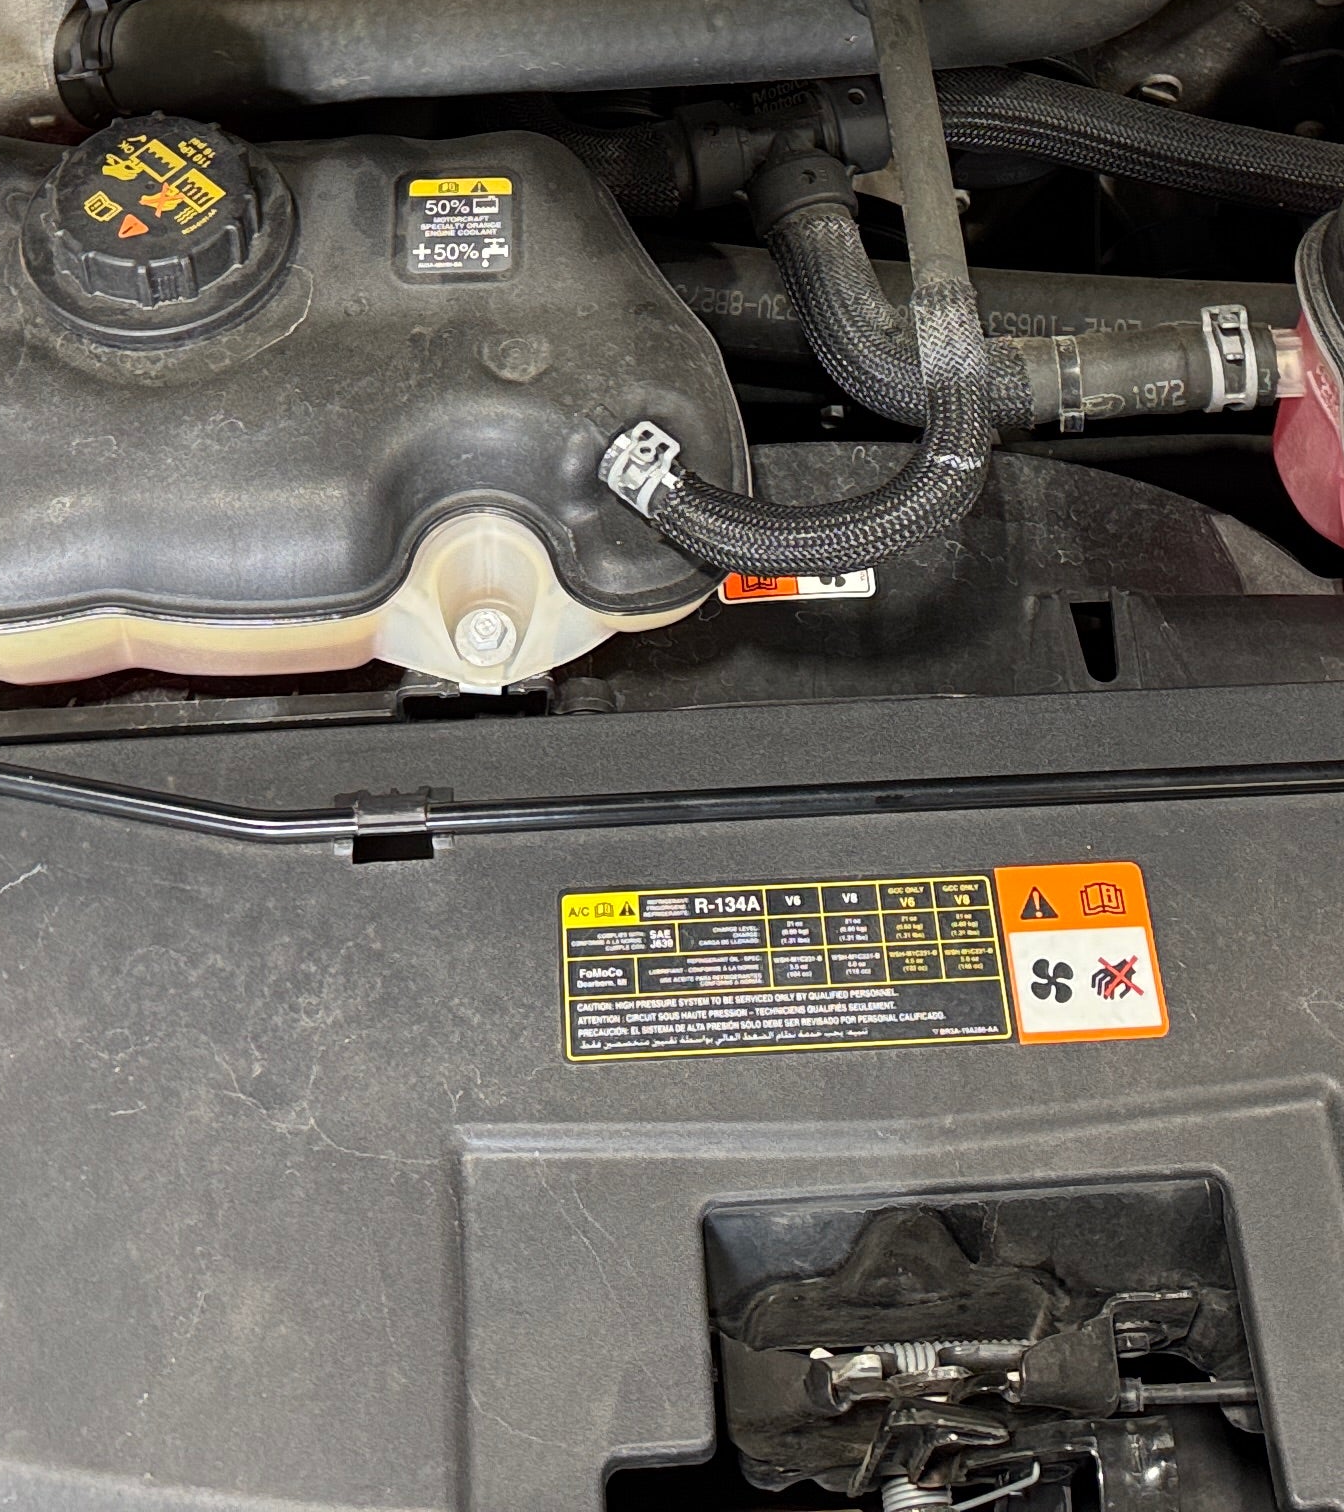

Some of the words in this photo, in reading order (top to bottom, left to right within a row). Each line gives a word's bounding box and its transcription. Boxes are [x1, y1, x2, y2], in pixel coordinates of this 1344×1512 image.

[117, 140, 135, 153] OK
[425, 199, 470, 215] 50%
[433, 215, 489, 223] MOTORCRAFT
[466, 221, 502, 229] ORANGE
[425, 229, 455, 237] ENGINE
[457, 228, 497, 236] COOLANT
[784, 895, 801, 906] V6
[841, 892, 858, 903] V8
[899, 897, 915, 907] V6
[953, 894, 970, 905] V8
[694, 895, 760, 913] R-134A
[568, 906, 589, 917] A/C
[649, 929, 670, 939] SAE
[649, 938, 673, 949] J639
[579, 967, 623, 978] FoMoCo
[576, 1001, 614, 1012] CAUTION:
[614, 1000, 634, 1010] HIGH
[635, 998, 677, 1009] PRESSURE
[678, 996, 709, 1007] SYSTEM
[710, 996, 721, 1005] TO
[722, 995, 733, 1004] BE
[735, 993, 773, 1004] SERVICED
[774, 992, 795, 1002] ONLY
[795, 992, 807, 1000] BY
[808, 989, 849, 1000] QUALIFIED
[849, 987, 899, 998] PERSONNEL.
[577, 1014, 620, 1025] ATTENTION
[625, 1012, 656, 1023] CIRCUIT
[657, 1011, 679, 1021] SOUS
[680, 1010, 707, 1020] HAUTE
[708, 1008, 747, 1019] PRESSION
[630, 1025, 640, 1034] EL
[641, 1023, 673, 1034] SISTEMA
[674, 1023, 685, 1032] DE
[686, 1022, 705, 1031] ALTA
[762, 1018, 782, 1028] DEBE
[783, 1018, 800, 1028] SER
[800, 1016, 839, 1027] REVISADO
[839, 1015, 856, 1024] POR
[857, 1013, 898, 1024] PERSONAL
[898, 1010, 946, 1022] CALIFICADO.
